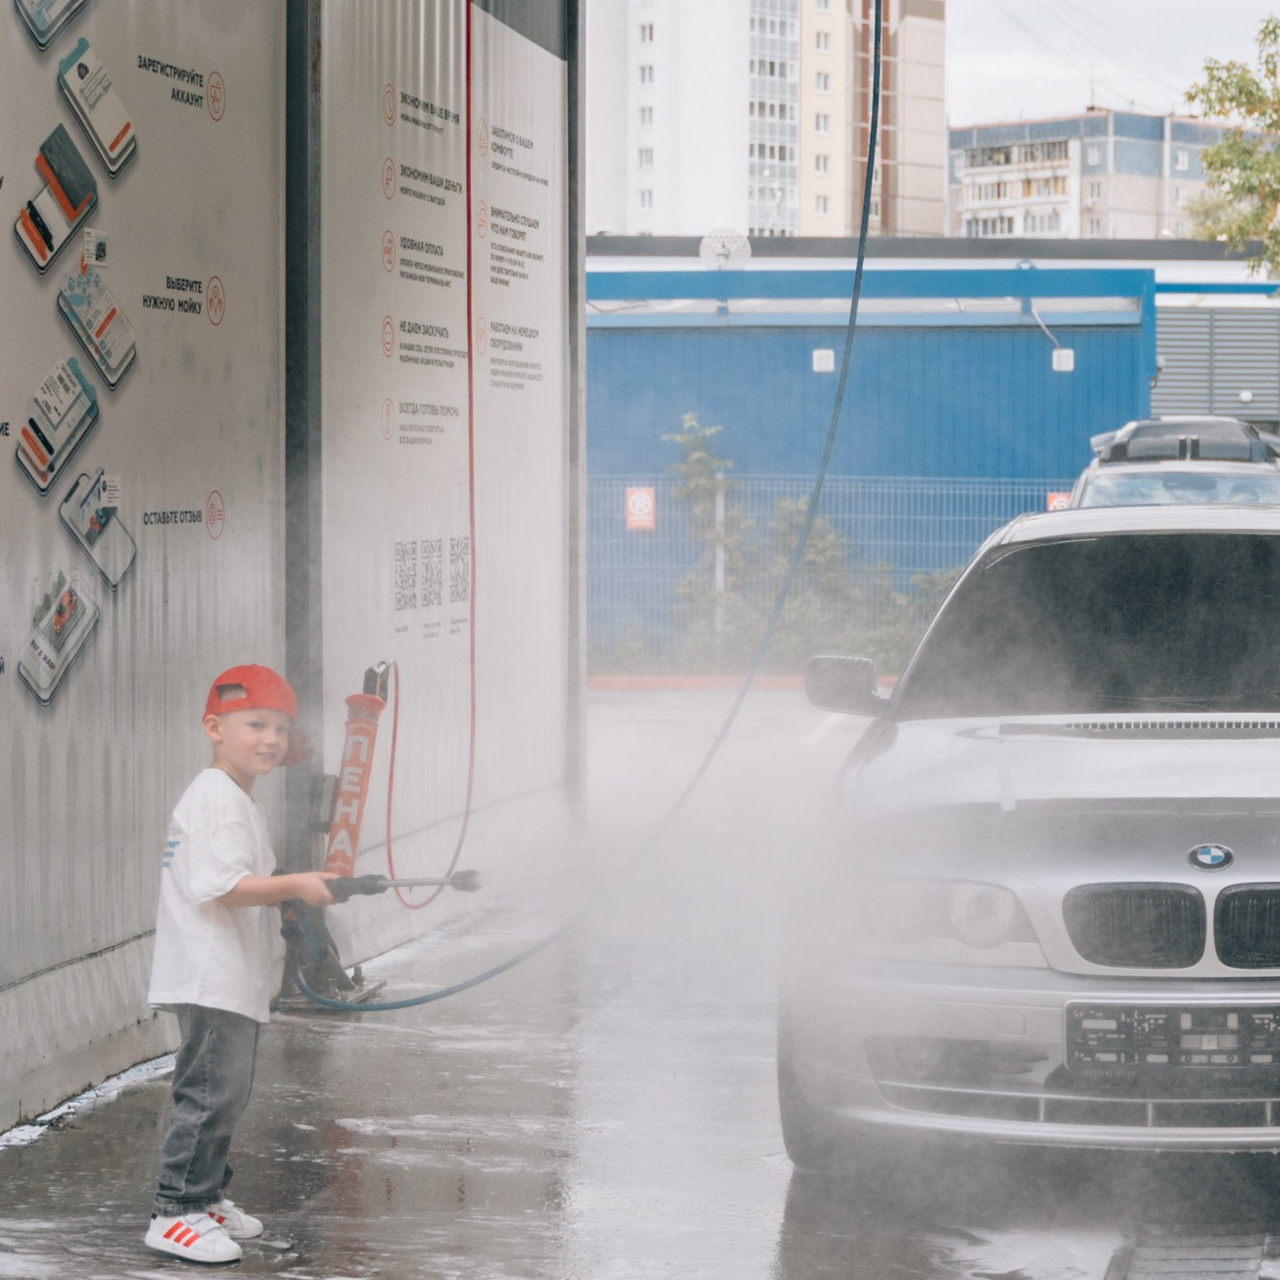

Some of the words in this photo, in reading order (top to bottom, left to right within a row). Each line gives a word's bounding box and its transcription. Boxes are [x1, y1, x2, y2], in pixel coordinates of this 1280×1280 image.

[138, 55, 204, 87] ЗАРЕГИСТРИРУЙТЕ
[171, 88, 204, 109] АККАУНТ
[166, 276, 202, 294] ВЫБЕРИТЕ
[142, 294, 175, 312] НУЖНУЮ
[177, 296, 202, 315] МОЙКУ
[143, 510, 179, 526] ОСТАВЬТЕ
[180, 509, 203, 524] ОТЗЫВ
[330, 734, 370, 858] ПЕНА
